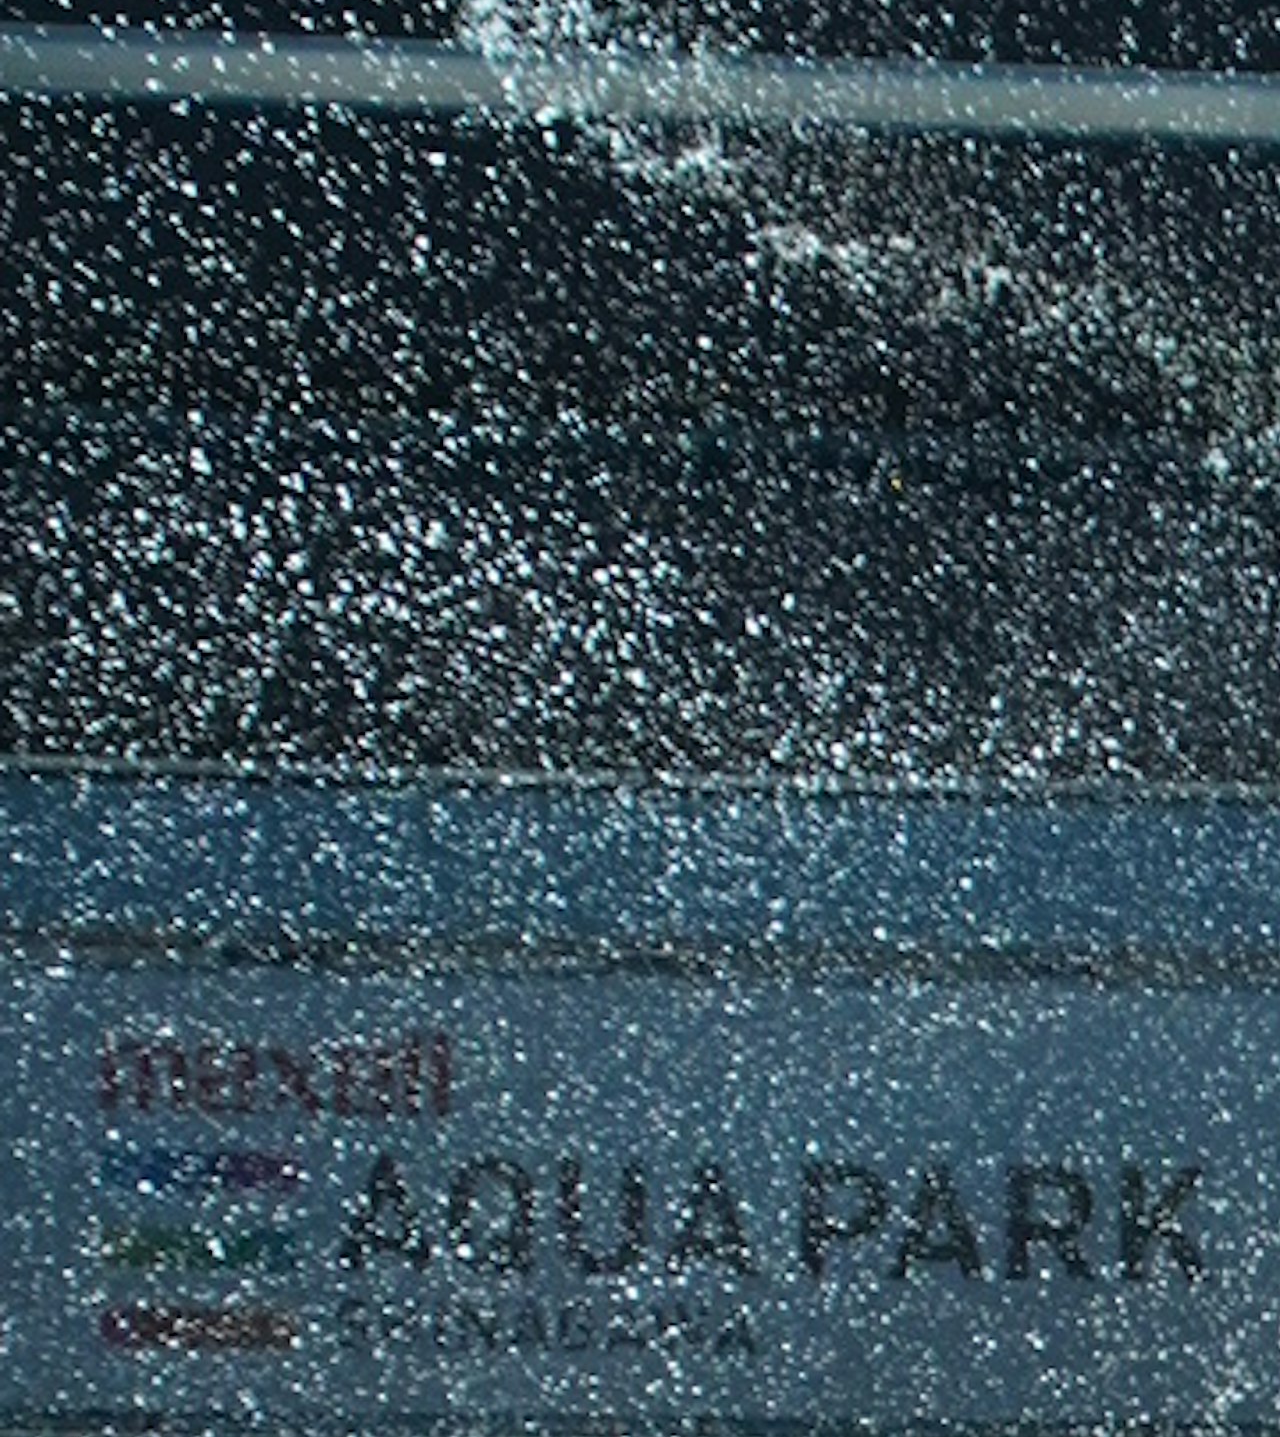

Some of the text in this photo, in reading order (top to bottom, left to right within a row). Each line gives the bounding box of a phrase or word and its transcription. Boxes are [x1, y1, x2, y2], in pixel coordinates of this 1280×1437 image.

[100, 1032, 450, 1118] maxell
[339, 1154, 1208, 1282] AQUA PARK
